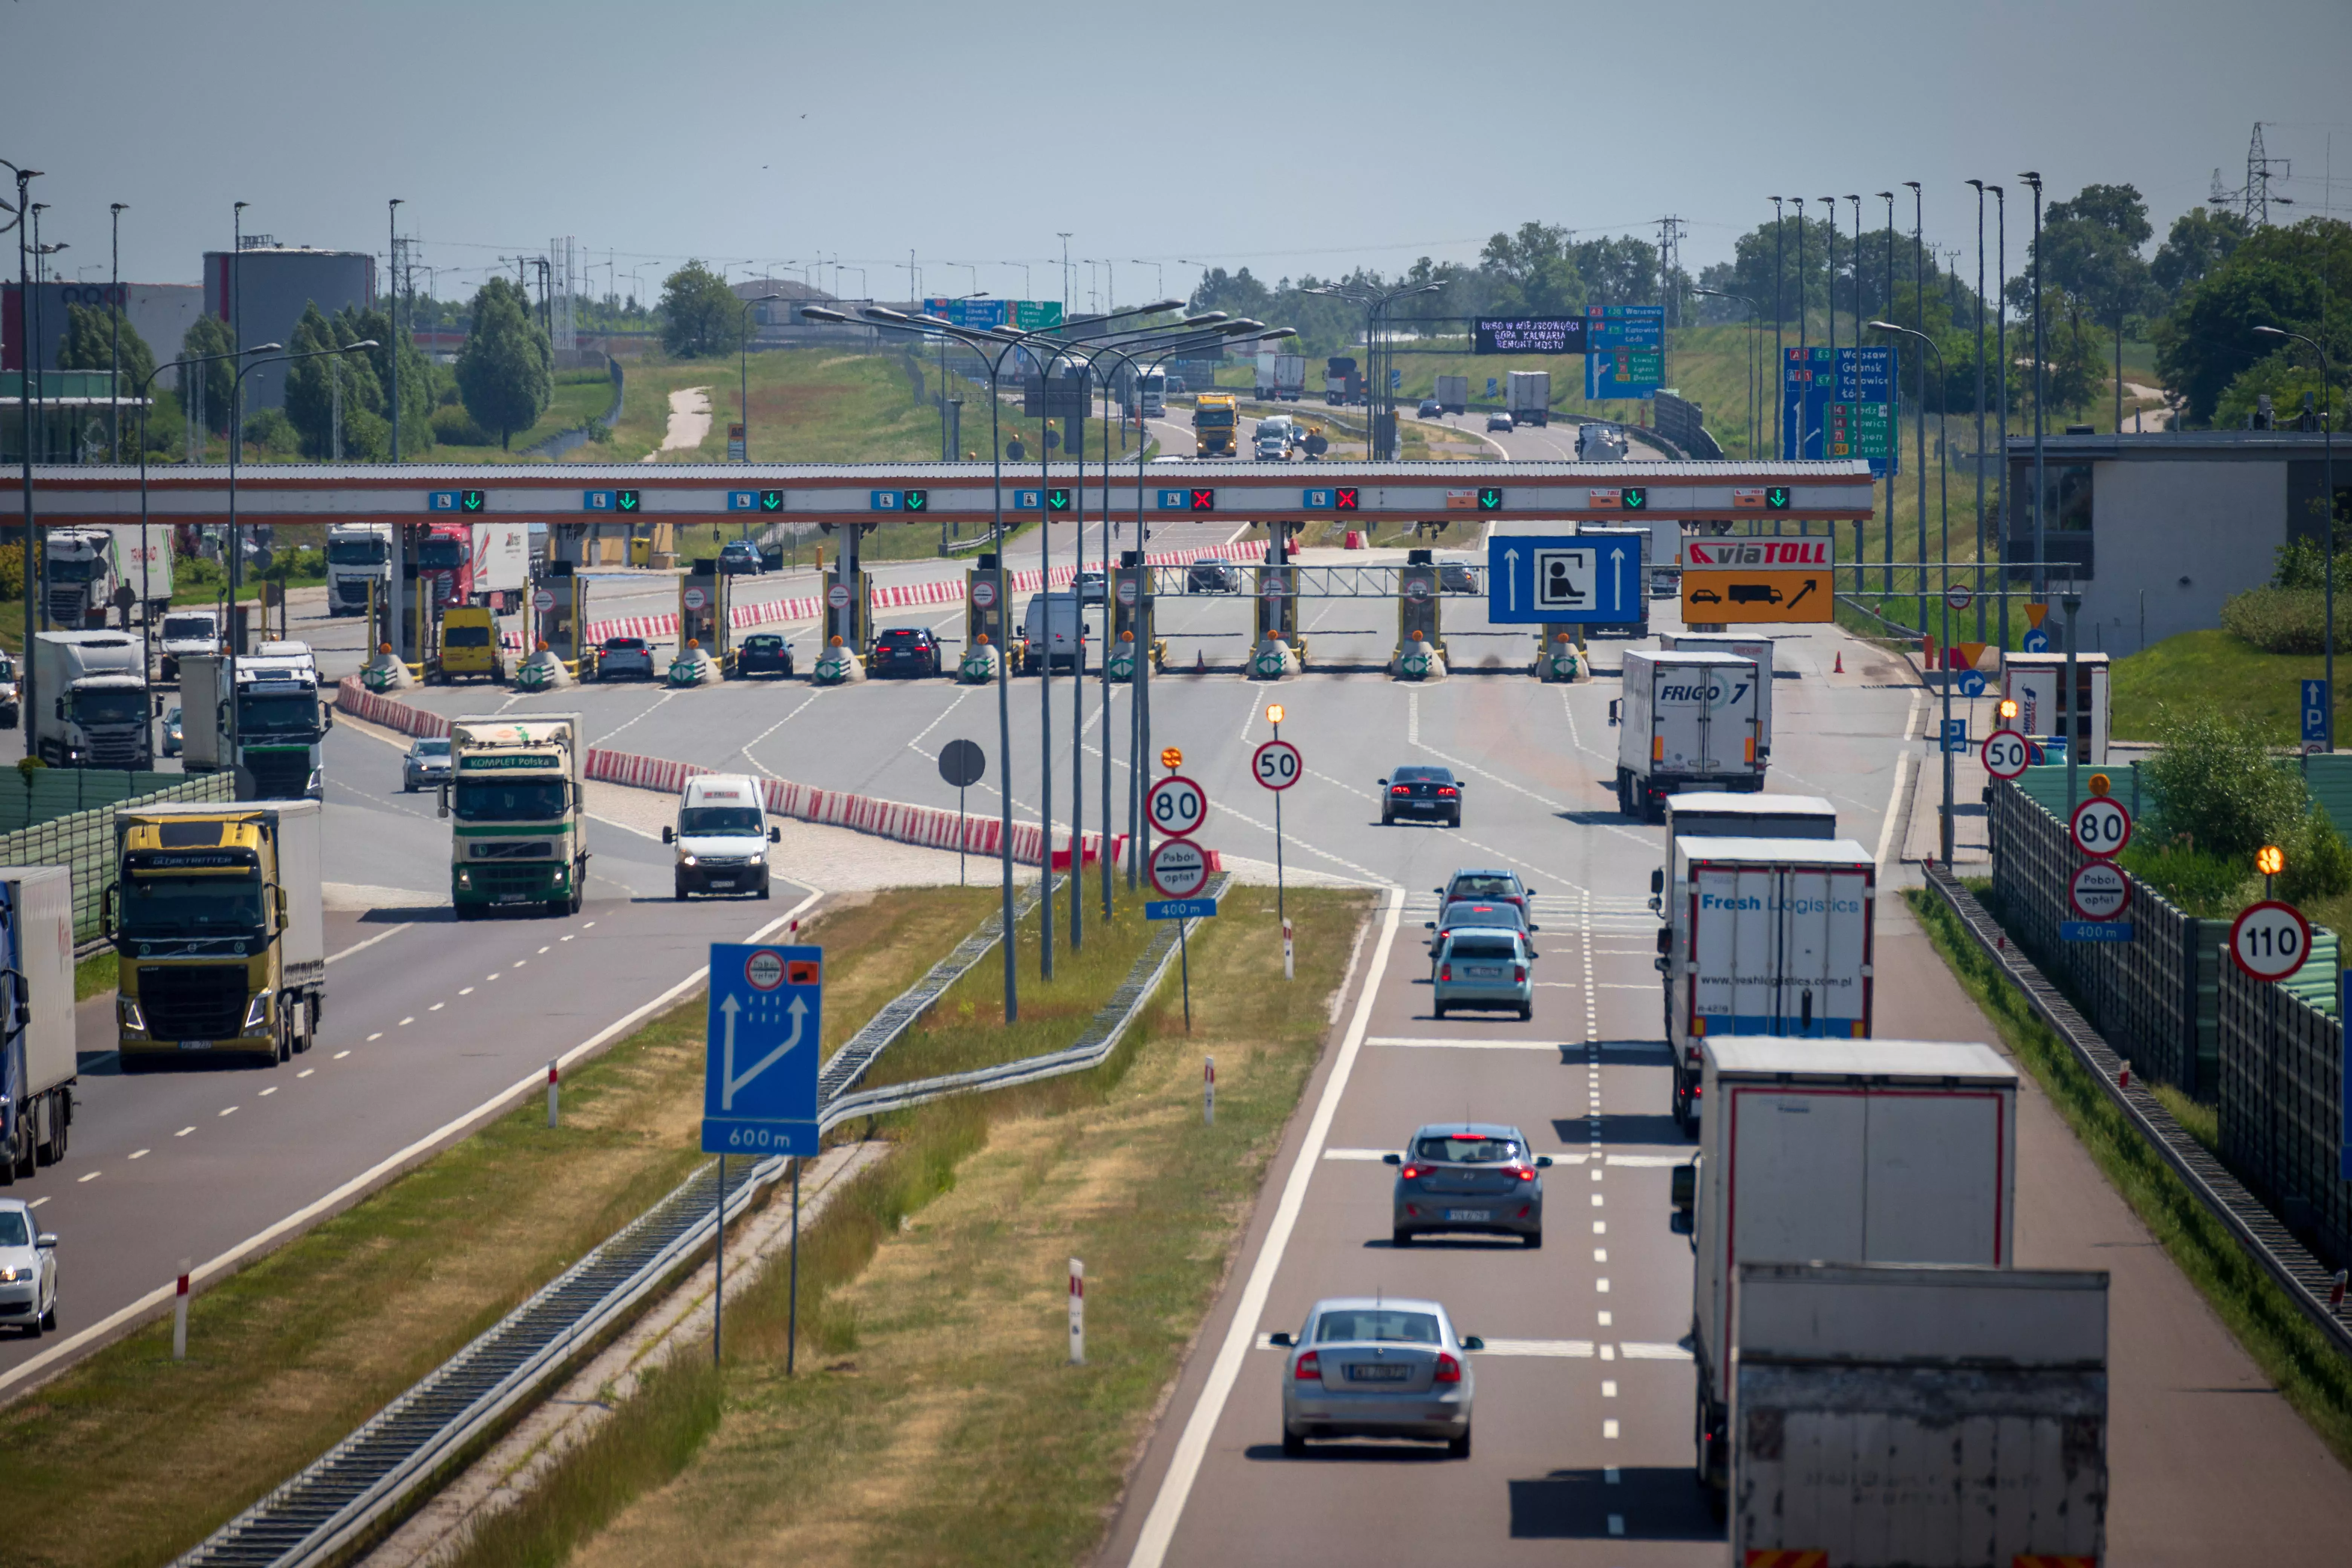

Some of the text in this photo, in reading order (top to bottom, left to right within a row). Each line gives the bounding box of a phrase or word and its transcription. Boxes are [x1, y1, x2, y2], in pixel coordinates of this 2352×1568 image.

[1506, 322, 1513, 330] W
[1497, 340, 1563, 349] REMONT MOSTU
[1844, 376, 1888, 385] Kaowice
[1718, 543, 1826, 564] viaTOLL
[1660, 683, 1750, 704] FRIGO 7
[2307, 709, 2322, 730] P
[471, 757, 549, 767] KOMPLET Polska
[1991, 743, 2023, 766] 50
[1261, 753, 1295, 778] 50
[1156, 792, 1197, 821] 80
[2080, 813, 2121, 842] 80
[1163, 852, 1195, 863] Pobór
[1164, 871, 1194, 885] opłat
[2084, 873, 2116, 885] Pobór
[1702, 894, 1761, 911] Fresh
[2085, 896, 2114, 906] opłat
[1161, 903, 1200, 916] 400 m
[2077, 926, 2117, 937] 400 m
[2246, 926, 2297, 957] 110
[729, 1126, 790, 1148] 600 m
